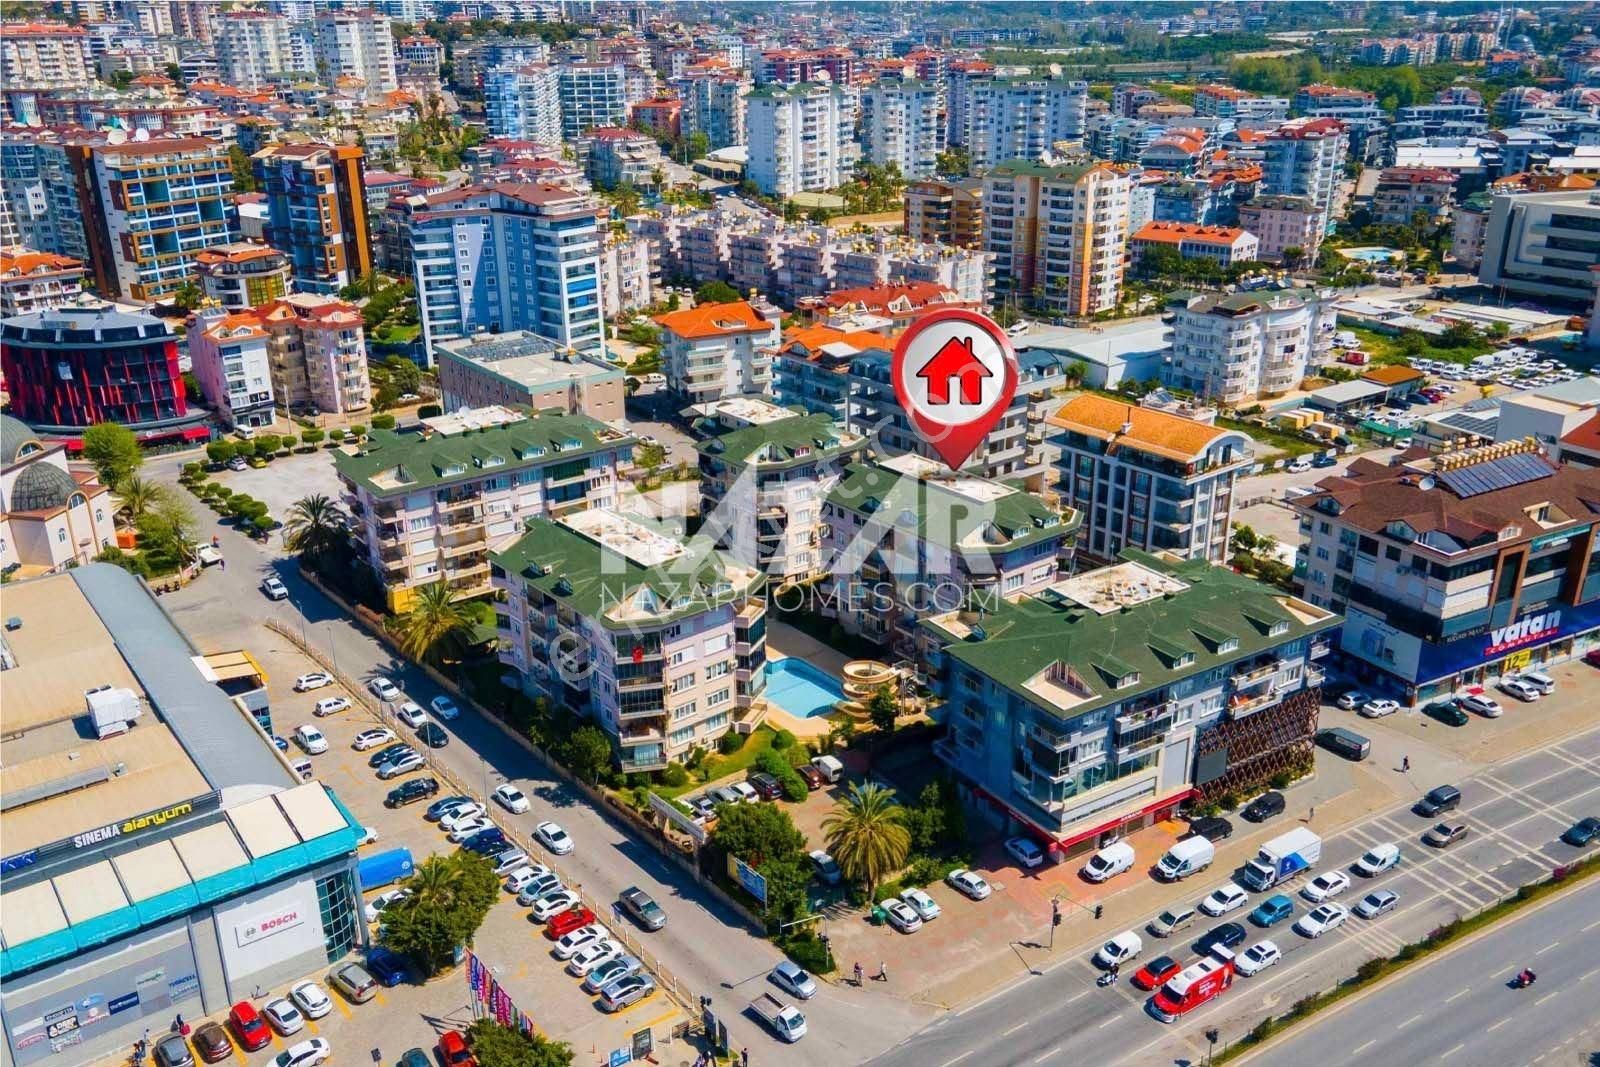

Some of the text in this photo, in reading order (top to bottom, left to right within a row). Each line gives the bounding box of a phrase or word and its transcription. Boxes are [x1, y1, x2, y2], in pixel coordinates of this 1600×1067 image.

[1490, 610, 1561, 647] vatan
[1505, 655, 1520, 672] 12
[73, 803, 192, 849] SINEMA alanyum
[261, 912, 297, 931] BOSCH
